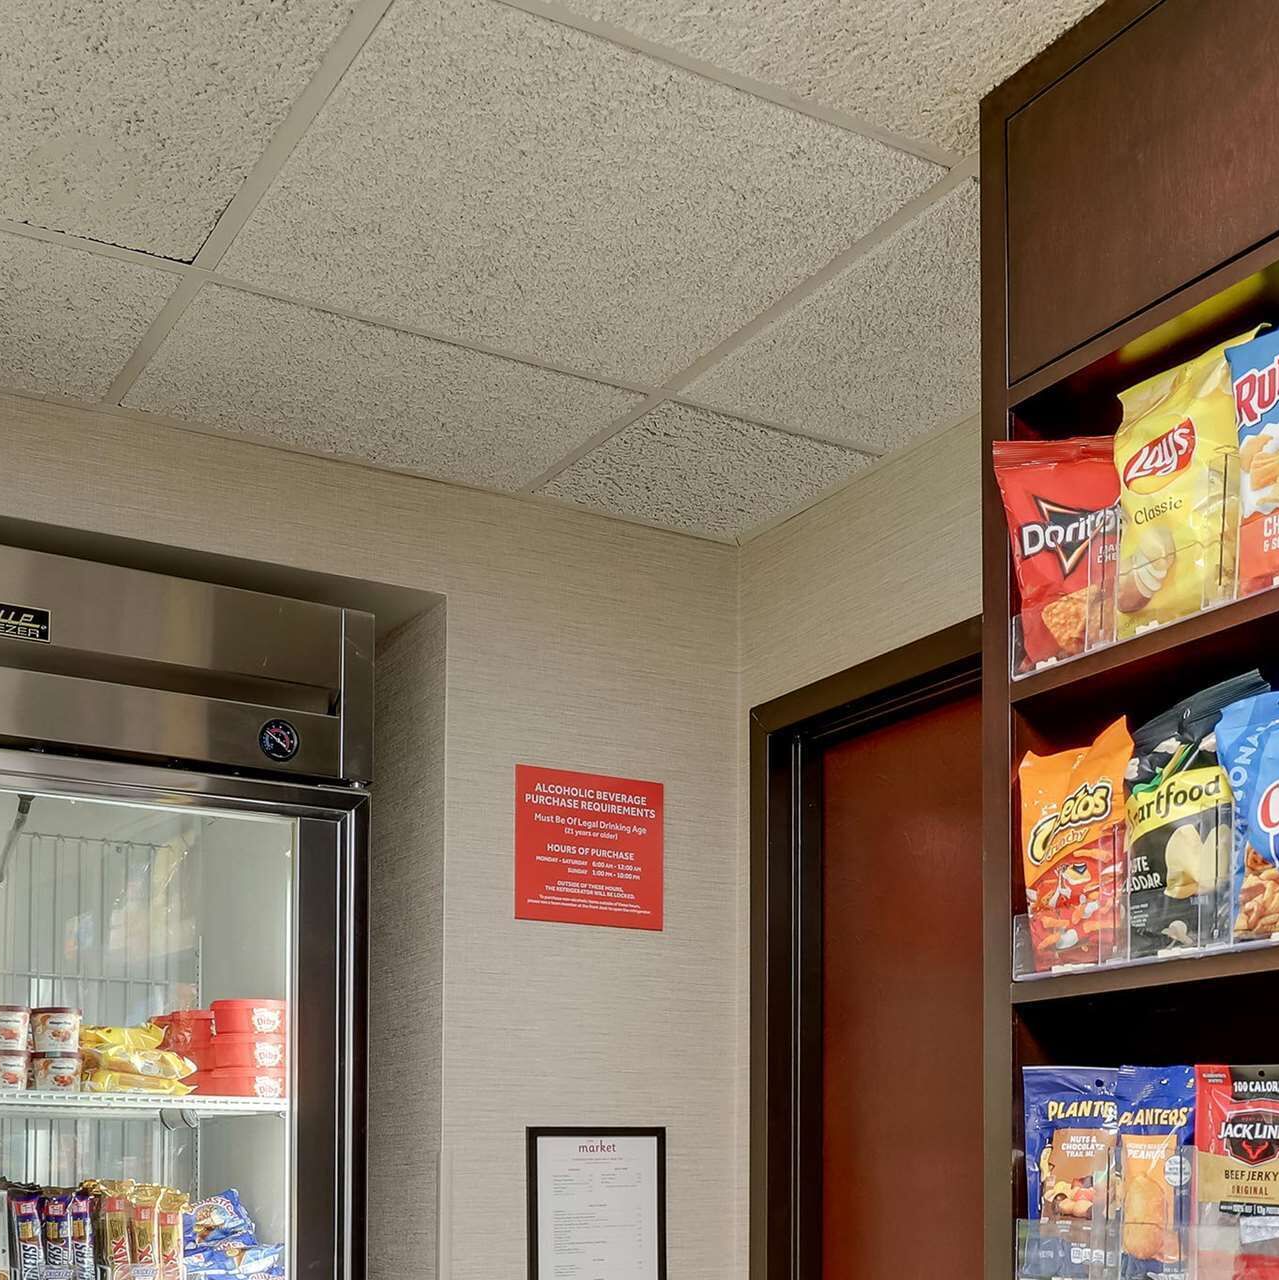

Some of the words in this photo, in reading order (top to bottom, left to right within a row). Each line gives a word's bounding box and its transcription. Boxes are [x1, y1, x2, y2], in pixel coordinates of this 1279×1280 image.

[1125, 422, 1193, 484] Lay's
[1133, 495, 1185, 527] Classic
[1263, 537, 1272, 552] &
[535, 782, 595, 799] ALCOHOLIC
[596, 791, 647, 806] BEVERAGE
[525, 793, 579, 809] PURCHASE
[580, 801, 656, 819] REQUIREMENTS
[534, 812, 554, 823] Must
[555, 816, 566, 825] Be
[566, 816, 577, 826] Of
[578, 818, 599, 830] Legal
[600, 821, 631, 834] Drinking
[631, 825, 647, 836] Age
[575, 829, 592, 838] years
[600, 831, 618, 841] older)
[547, 843, 577, 855] HOURS
[578, 846, 590, 856] OF
[591, 848, 635, 861] PURCHASE
[535, 855, 558, 863] MONDAY
[562, 858, 588, 866] SATURDAY
[1233, 1081, 1248, 1092] 100
[1119, 1108, 1189, 1127] PLANTERS
[578, 1140, 617, 1153] market
[1061, 1143, 1106, 1151] CHOCOLATE
[1224, 1170, 1245, 1180] BEEF
[1246, 1170, 1279, 1182] JERKY
[1231, 1184, 1269, 1196] ORIGINAL
